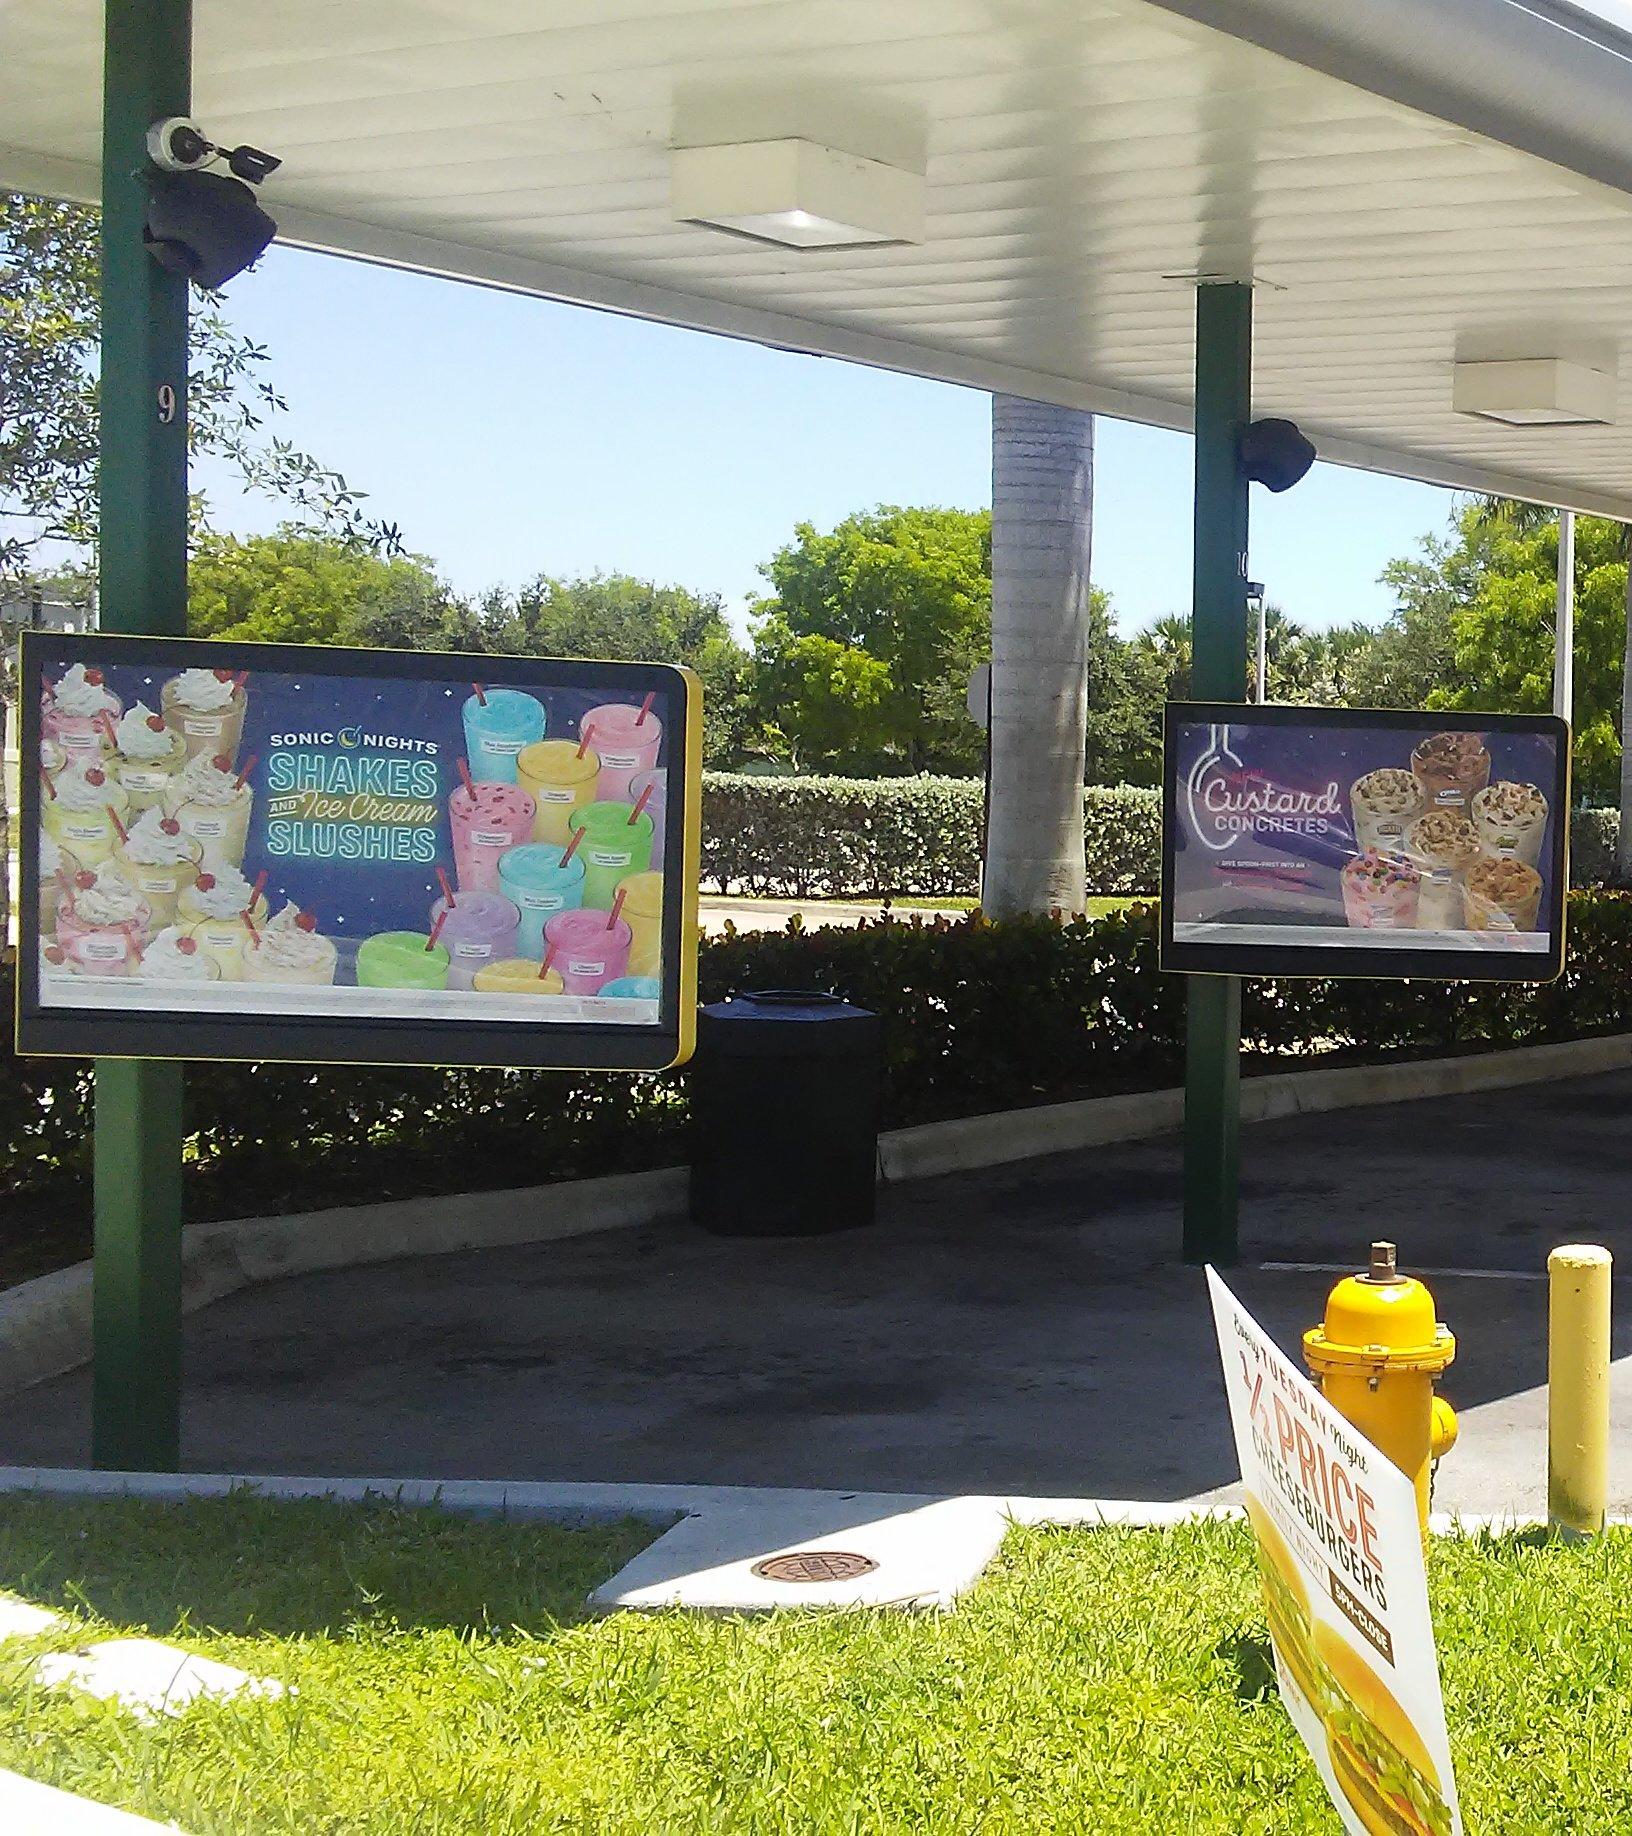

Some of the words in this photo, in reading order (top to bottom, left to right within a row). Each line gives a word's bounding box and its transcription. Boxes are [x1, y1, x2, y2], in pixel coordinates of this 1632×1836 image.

[158, 385, 176, 423] 9
[1237, 551, 1249, 577] 10
[270, 732, 334, 747] SONIC
[363, 734, 438, 755] NIGHTS
[268, 752, 438, 799] SHAKES
[270, 798, 297, 814] AND
[300, 790, 347, 822] Ice
[349, 793, 438, 824] Cream
[1204, 778, 1342, 815] Custard
[267, 820, 437, 863] SLUSHES
[1214, 815, 1329, 835] CONCRETES
[1260, 1347, 1328, 1436] TUESDAY
[1273, 1392, 1383, 1574] PRICE
[1252, 1424, 1388, 1613] CHEESEBURGERS
